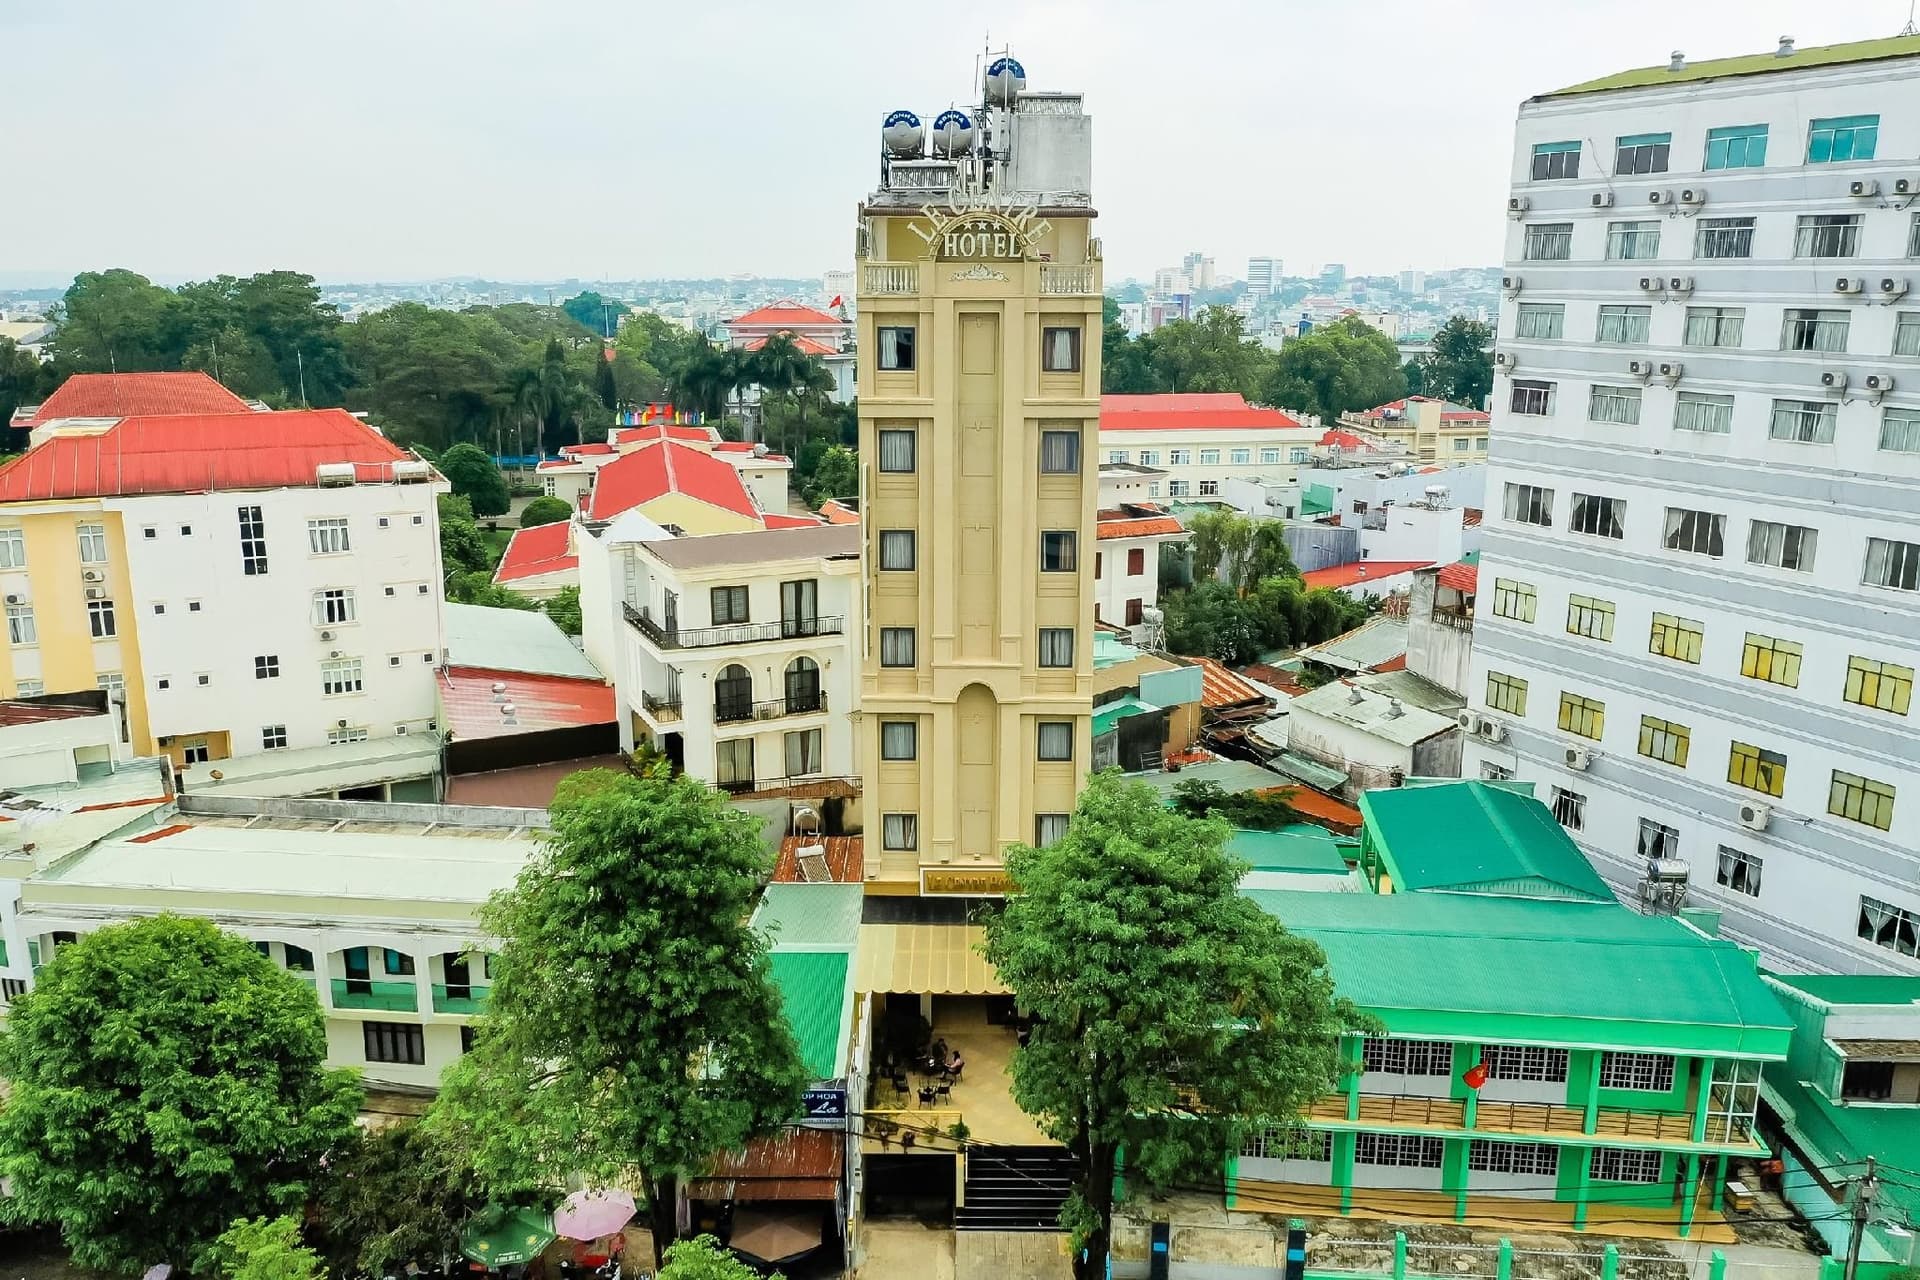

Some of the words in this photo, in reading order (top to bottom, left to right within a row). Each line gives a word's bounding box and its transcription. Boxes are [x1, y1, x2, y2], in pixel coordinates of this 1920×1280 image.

[907, 202, 949, 244] LE
[949, 181, 1053, 245] CENTRE
[943, 232, 1023, 258] HOTEL
[801, 1092, 815, 1100] OP
